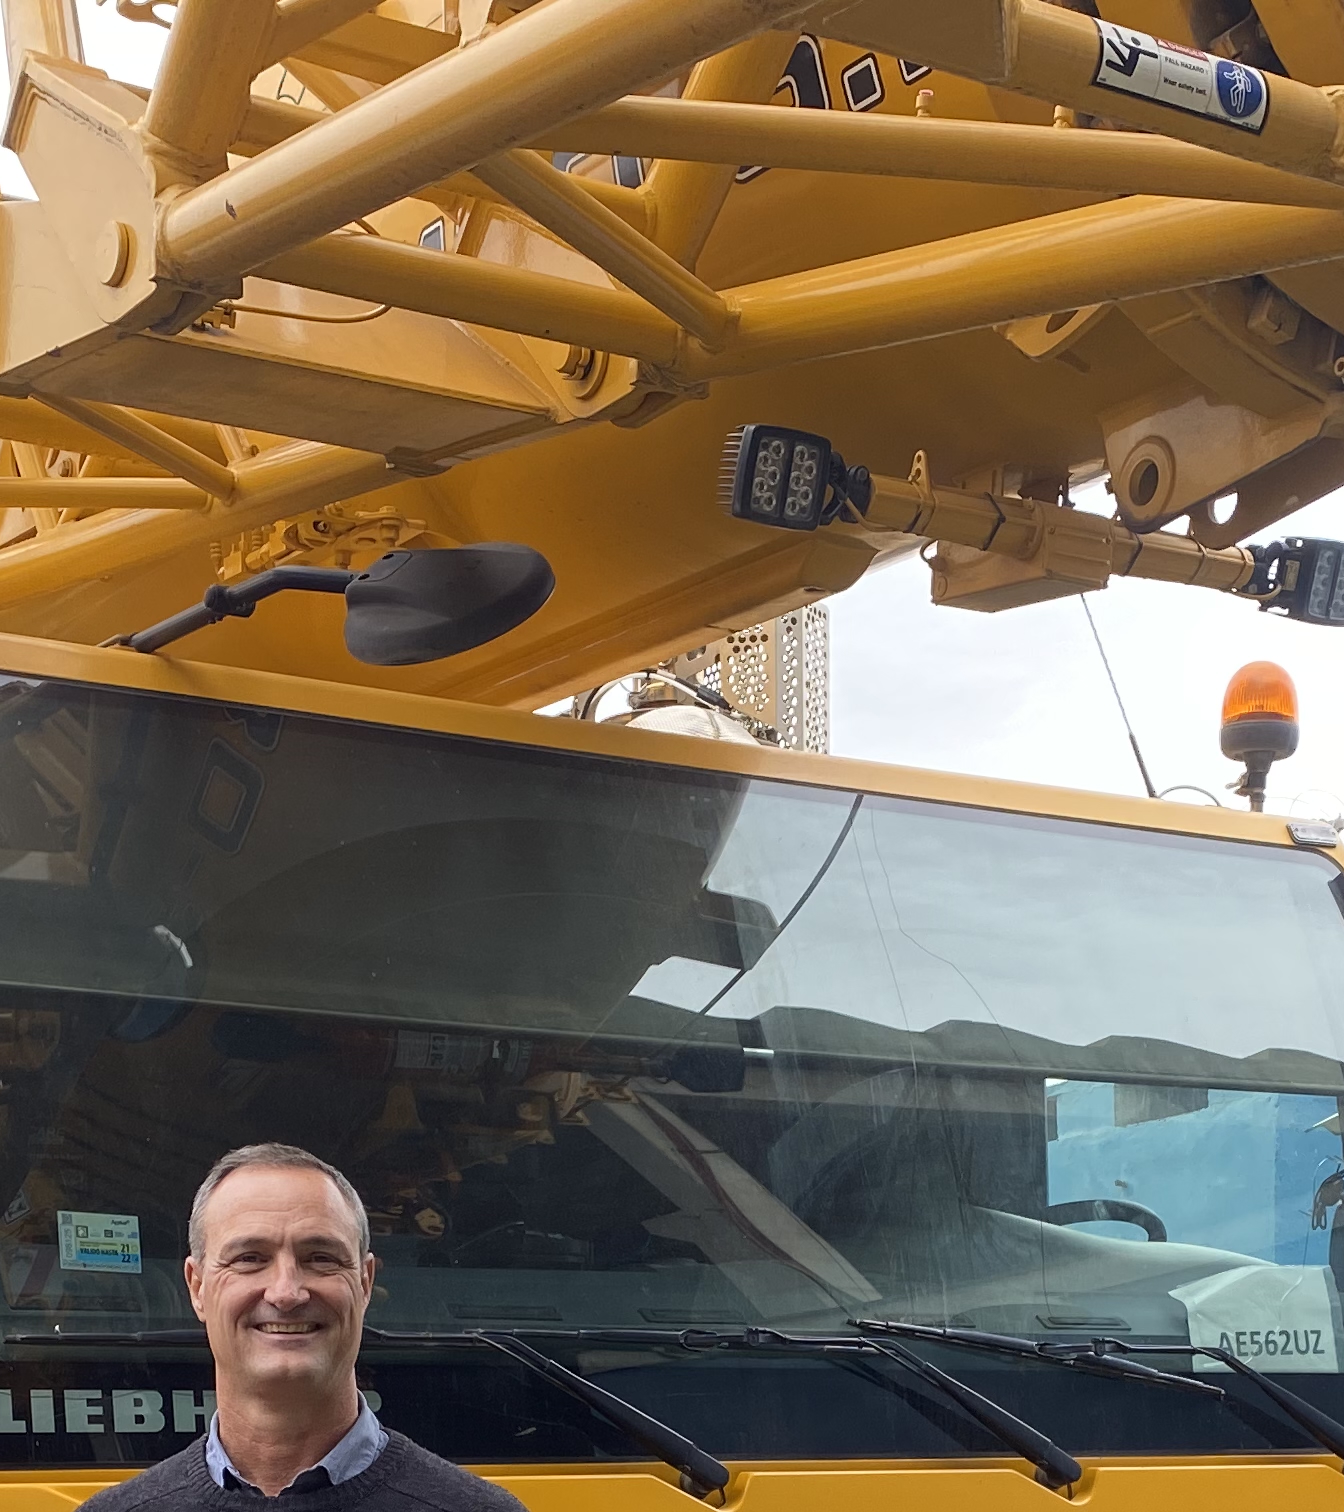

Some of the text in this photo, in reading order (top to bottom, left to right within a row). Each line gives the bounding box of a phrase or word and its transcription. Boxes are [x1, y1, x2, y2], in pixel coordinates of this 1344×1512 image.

[120, 1243, 130, 1253] 21
[121, 1253, 132, 1263] 22
[1218, 1329, 1326, 1357] AE562UZ
